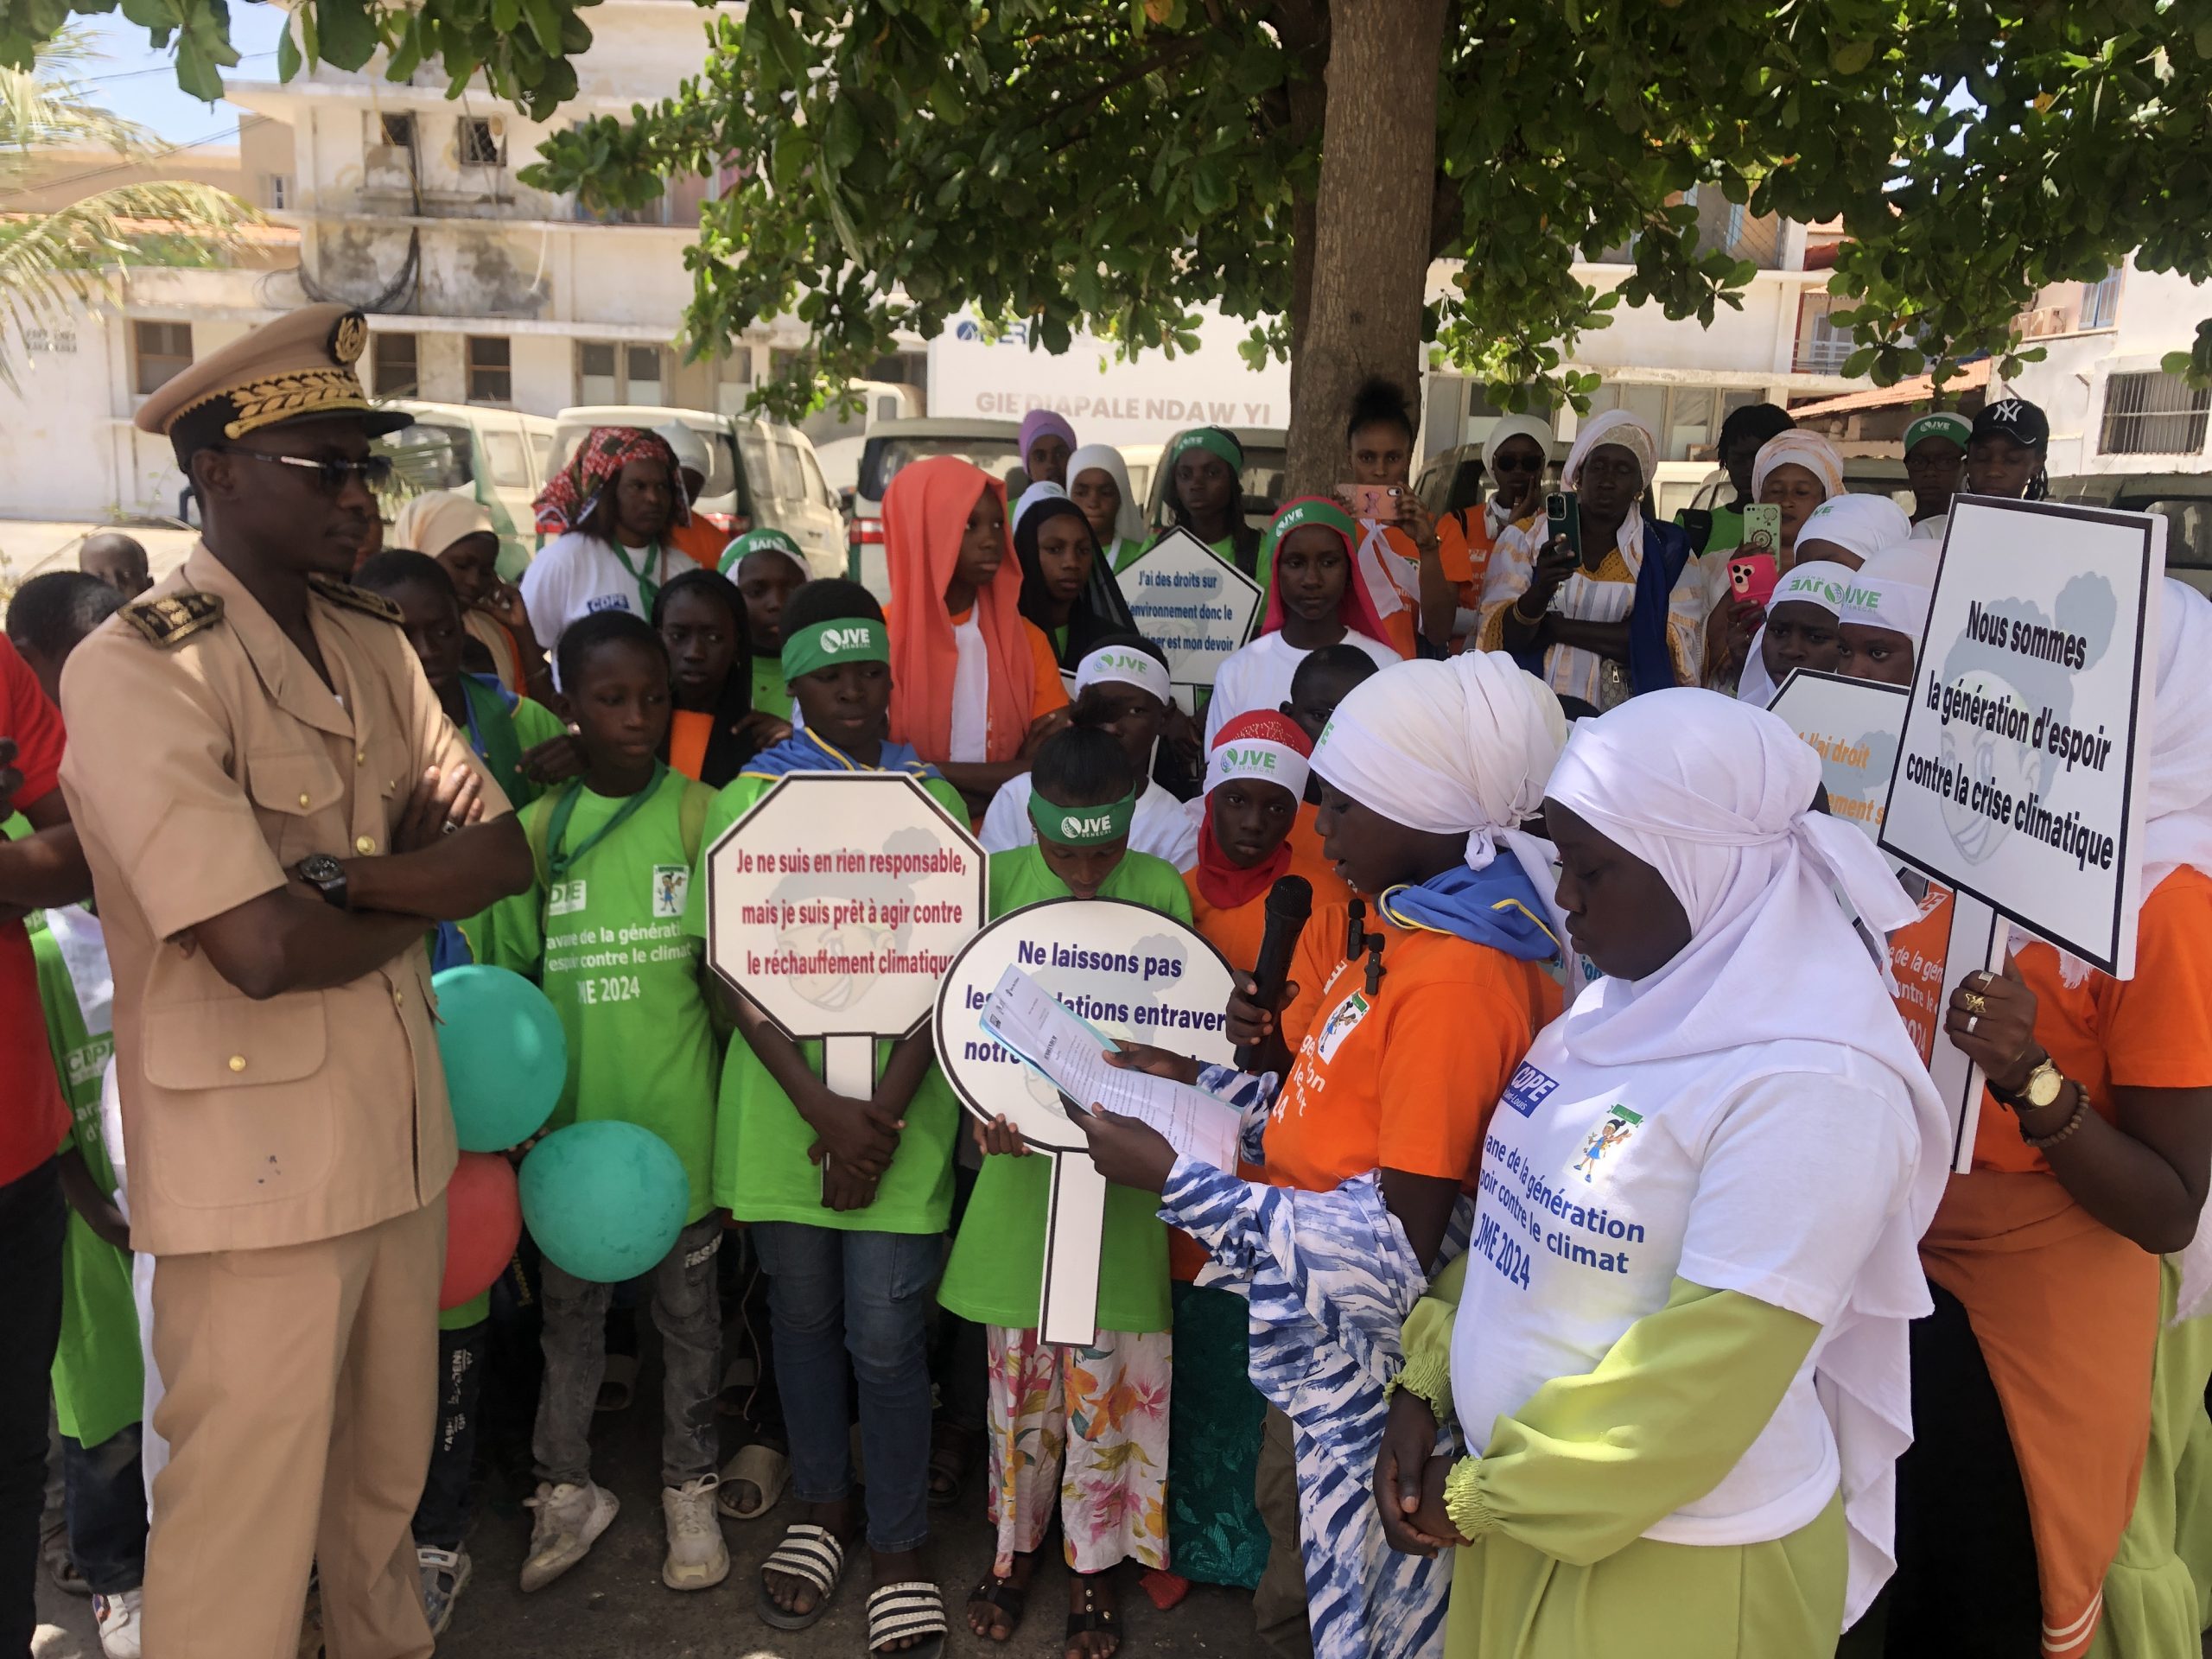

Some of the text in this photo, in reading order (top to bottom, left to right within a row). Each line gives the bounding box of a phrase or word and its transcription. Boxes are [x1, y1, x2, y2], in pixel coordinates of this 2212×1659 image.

[976, 391, 1020, 414] GIE
[1146, 399, 1236, 424] NDAW
[1243, 403, 1271, 425] YI
[1139, 570, 1217, 588] J'ai des droits sur
[1127, 601, 1232, 620] 'environnement donc le
[841, 628, 870, 645] JVE
[1167, 634, 1181, 649] est
[1183, 637, 1203, 650] mon
[1205, 636, 1234, 652] devoir
[1966, 600, 2088, 670] Nous sommes
[1116, 655, 1148, 674] JVE
[1926, 670, 2112, 772] la génération d'espoir
[1238, 749, 1277, 770] JVE
[1832, 739, 1871, 770] droit
[1081, 815, 1111, 834] JVE
[1906, 753, 2113, 872] contre la crise climatique
[737, 848, 966, 879] Je ne suis en rien responsable,
[741, 898, 963, 931] mais je suis prêt à agir contre
[580, 929, 596, 944] de
[600, 926, 614, 943] la
[619, 922, 681, 945] générati
[581, 951, 628, 968] contre
[632, 947, 646, 963] le
[747, 950, 760, 975] le
[765, 949, 874, 975] réchauffement
[1018, 940, 1182, 981] Ne laissons pas
[1895, 945, 1910, 967] de
[1910, 950, 1923, 973] la
[600, 975, 640, 1002] 2024
[1135, 1001, 1226, 1032] entraver
[1506, 1147, 1521, 1174] de
[1519, 1157, 1529, 1185] la
[1526, 1175, 1644, 1243] génération
[1498, 1184, 1527, 1229] contre
[1529, 1211, 1541, 1243] le
[1547, 1231, 1629, 1274] climat
[1473, 1212, 1530, 1291] JME 2024
